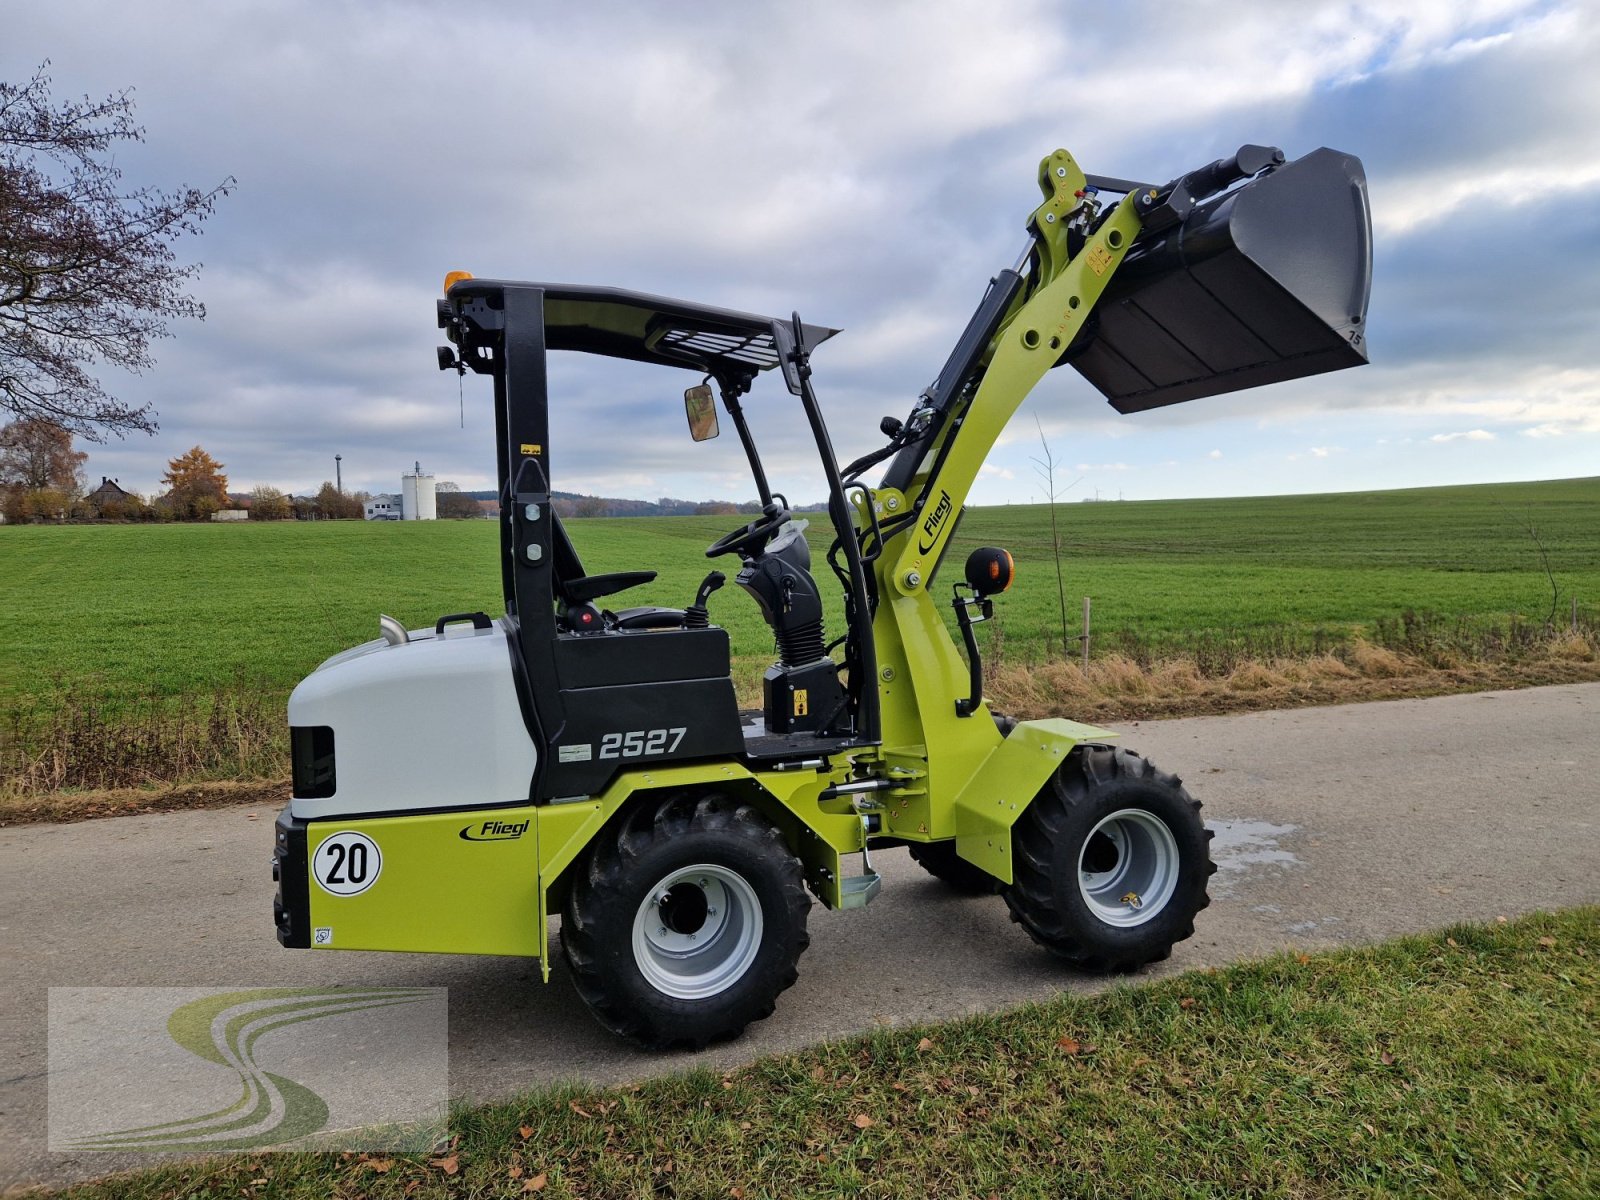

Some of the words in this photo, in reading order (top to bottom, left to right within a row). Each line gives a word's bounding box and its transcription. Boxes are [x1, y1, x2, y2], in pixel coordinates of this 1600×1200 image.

[924, 489, 951, 537] Fliegl
[599, 727, 687, 759] 2527
[480, 819, 531, 837] Fliegl
[326, 843, 367, 884] 20
